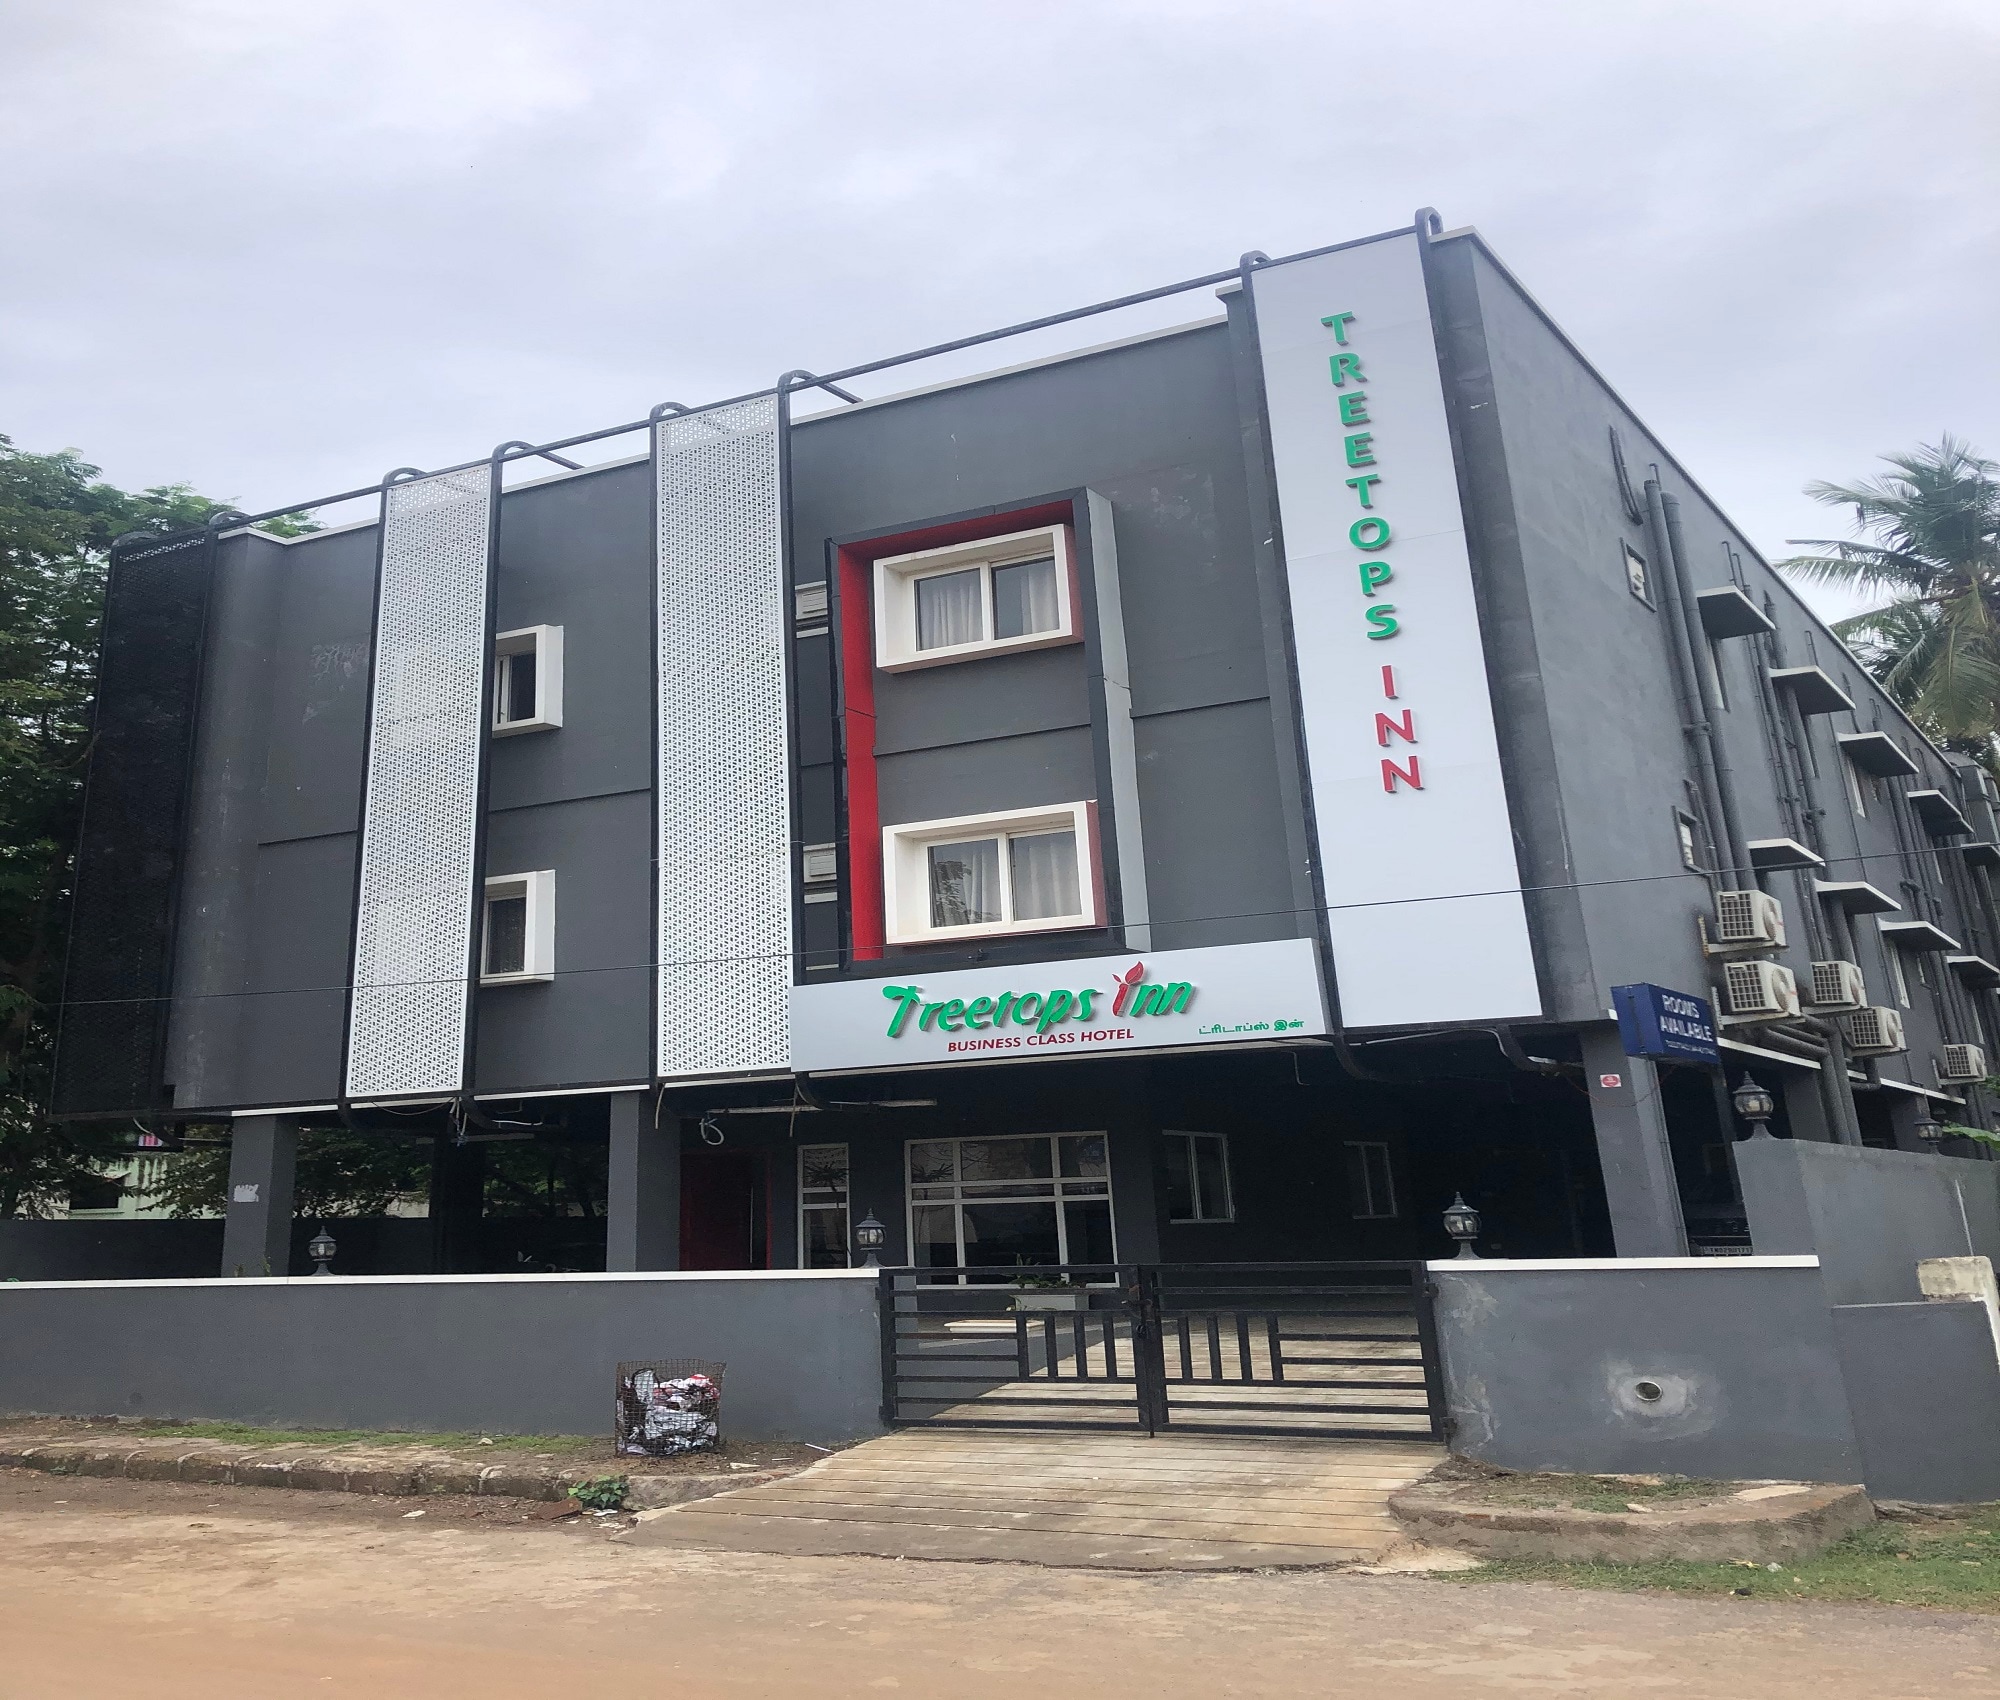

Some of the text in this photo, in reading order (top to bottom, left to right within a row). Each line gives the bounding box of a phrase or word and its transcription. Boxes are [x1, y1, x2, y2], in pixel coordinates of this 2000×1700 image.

[1321, 311, 1425, 793] TREETOPS INN
[882, 985, 1100, 1038] Treetops
[1661, 994, 1700, 1019] ROOMS
[1274, 1018, 1304, 1031] இன்
[1659, 1015, 1714, 1042] AVAILABLE
[947, 1028, 1135, 1052] BUSINESS CLASS HOTEL
